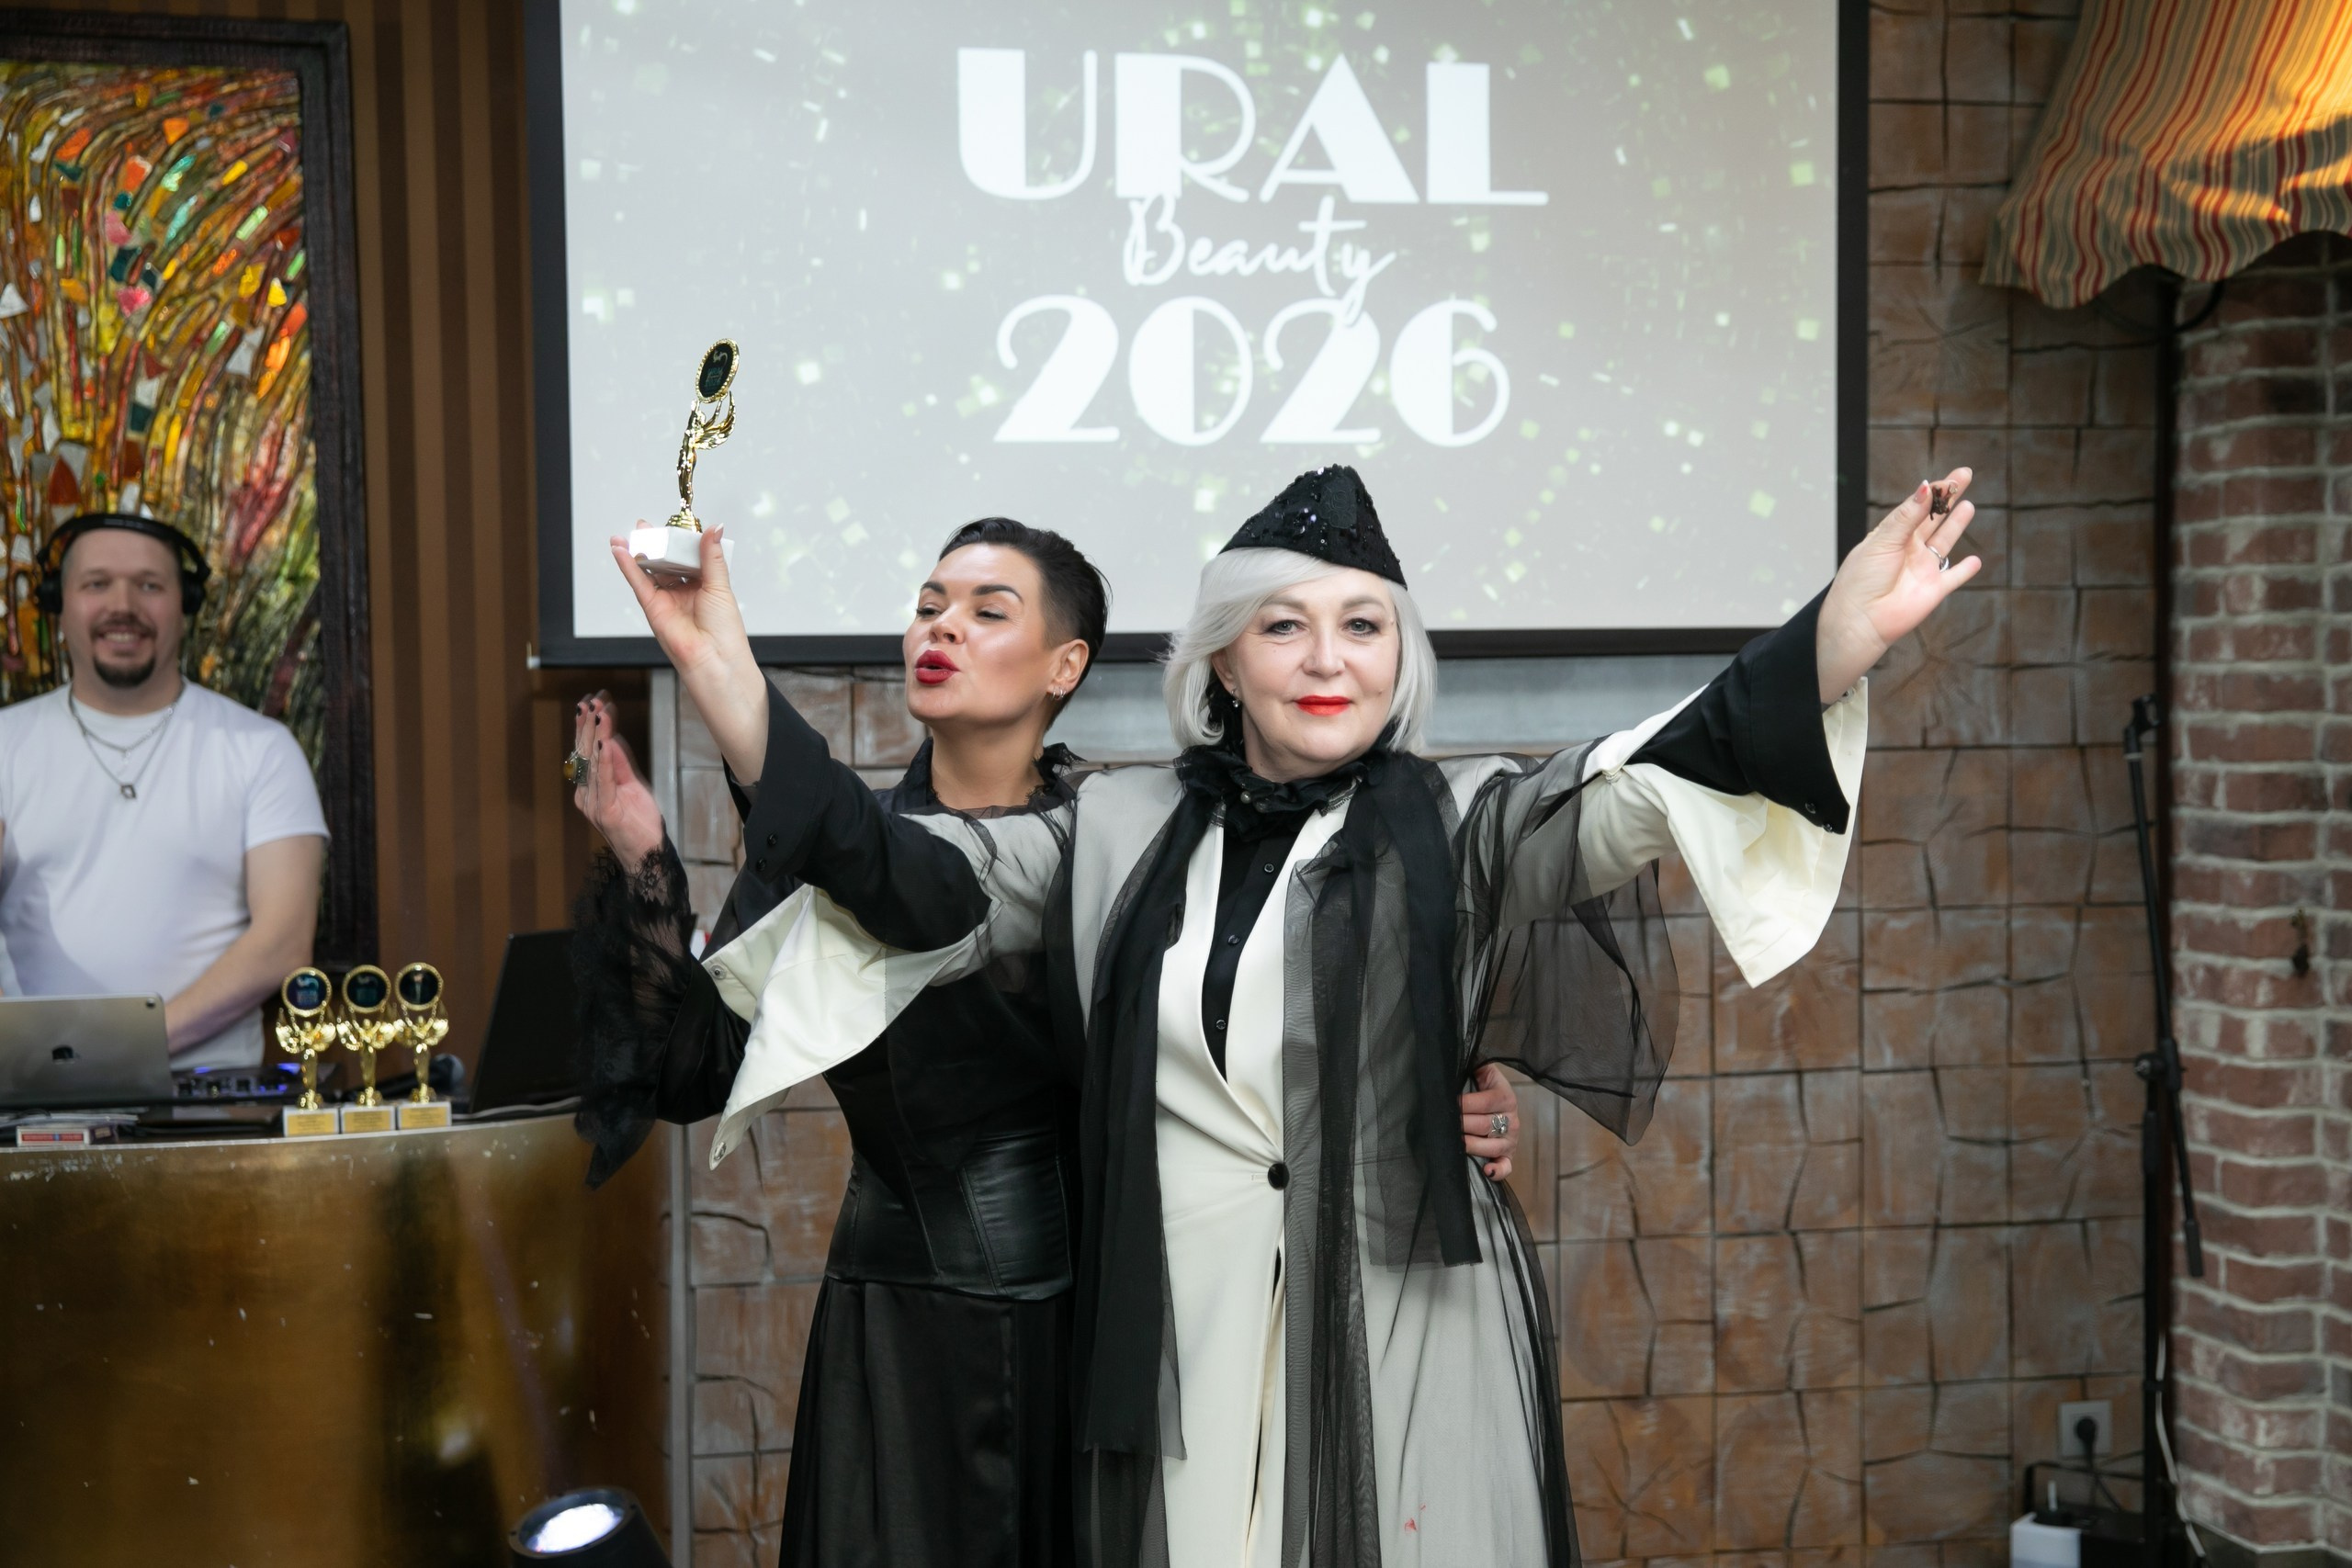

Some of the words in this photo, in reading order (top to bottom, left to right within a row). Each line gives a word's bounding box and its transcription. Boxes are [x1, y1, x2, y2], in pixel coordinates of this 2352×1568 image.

[956, 47, 1549, 205] URAL
[1122, 192, 1397, 328] Beauty
[992, 294, 1511, 448] 2026
